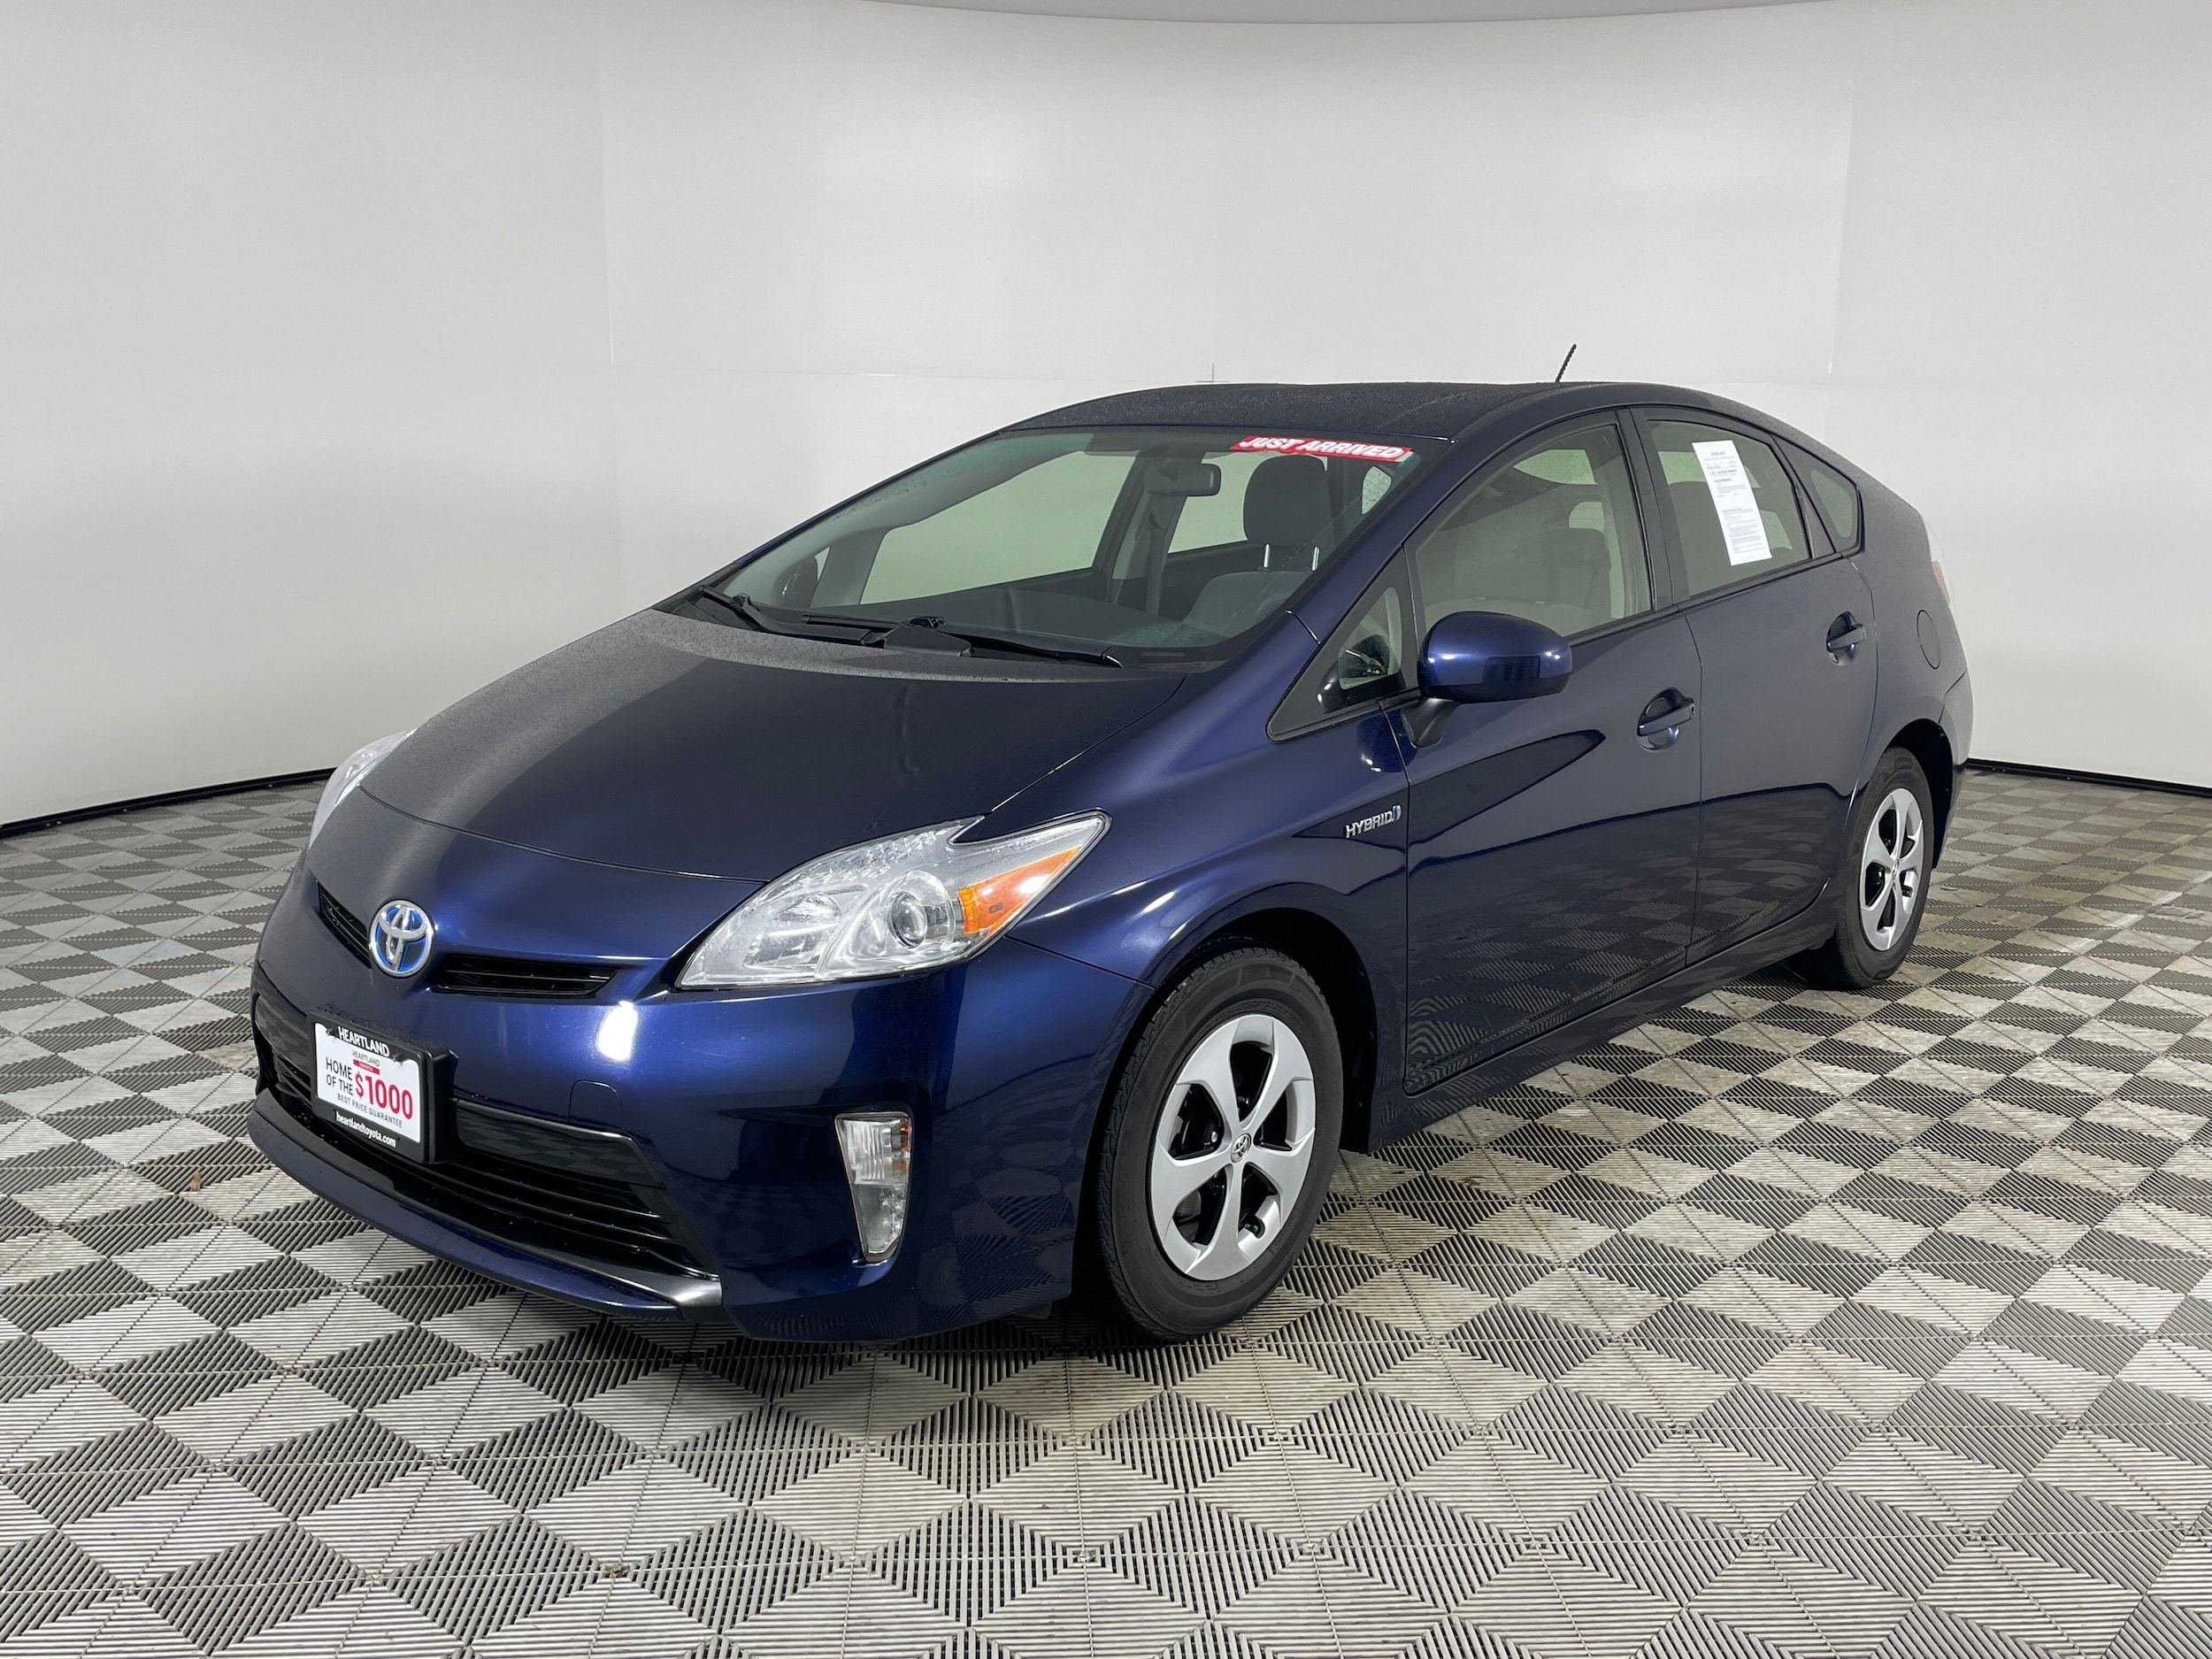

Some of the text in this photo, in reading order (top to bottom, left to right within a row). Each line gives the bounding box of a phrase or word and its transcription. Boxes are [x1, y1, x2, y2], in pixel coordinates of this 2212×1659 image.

[1239, 437, 1405, 457] JUST ARRIVED
[1345, 810, 1394, 838] HYBRID
[338, 1026, 389, 1056] HEARTLAND
[326, 1057, 353, 1080] HOME
[352, 1050, 380, 1066] HEARTLAND
[326, 1074, 353, 1096] OF THE
[355, 1071, 413, 1119] $1000
[338, 1094, 403, 1128] BEST PRICE GUARANTEE
[336, 1111, 396, 1148] heartlandtoyota.com
